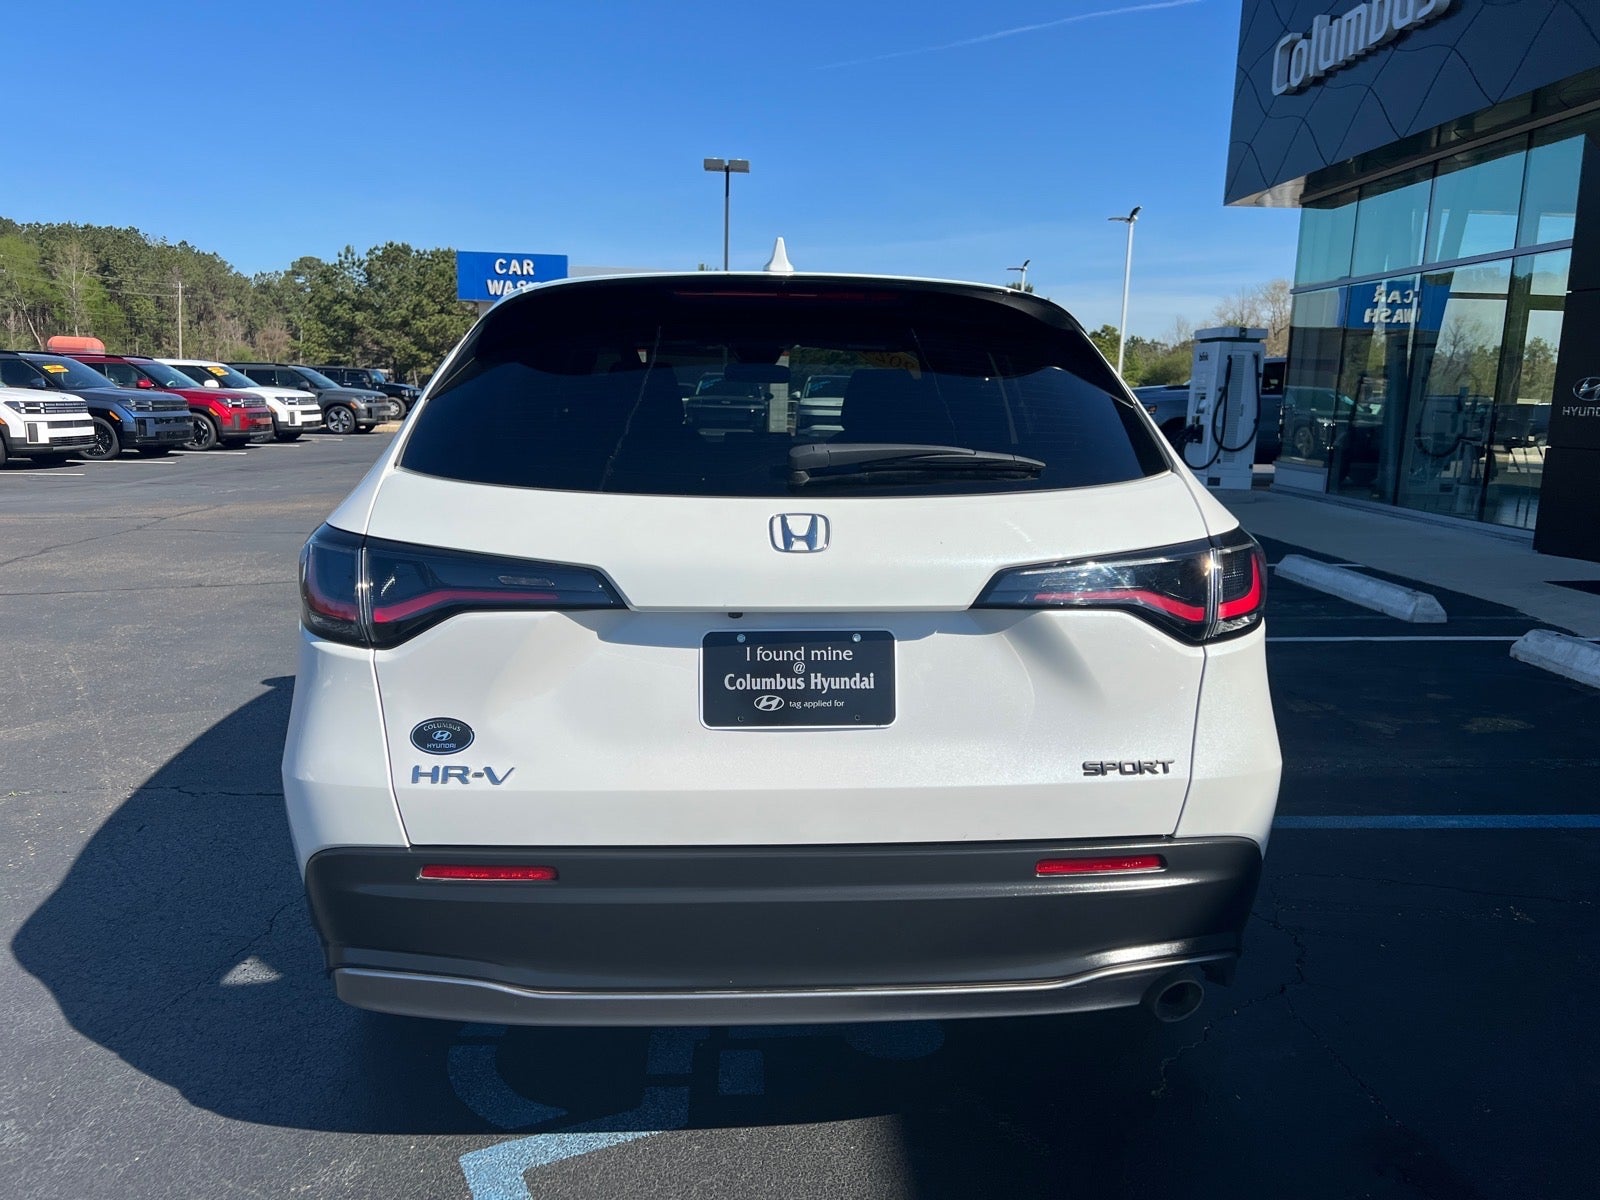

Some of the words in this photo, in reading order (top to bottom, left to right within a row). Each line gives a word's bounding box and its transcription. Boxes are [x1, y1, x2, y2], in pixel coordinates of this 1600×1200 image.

[494, 258, 534, 276] CAR
[486, 279, 542, 297] WAS
[746, 647, 751, 662] I
[757, 646, 805, 661] found
[811, 647, 853, 661] mine
[793, 662, 806, 674] @
[724, 673, 805, 690] Columbus
[810, 673, 875, 694] Hyundai
[789, 700, 802, 709] tag
[803, 700, 832, 709] applied
[834, 699, 845, 708] for
[423, 722, 462, 732] COLUMBUS
[411, 765, 516, 786] HR-V
[1082, 760, 1175, 776] SPORT
